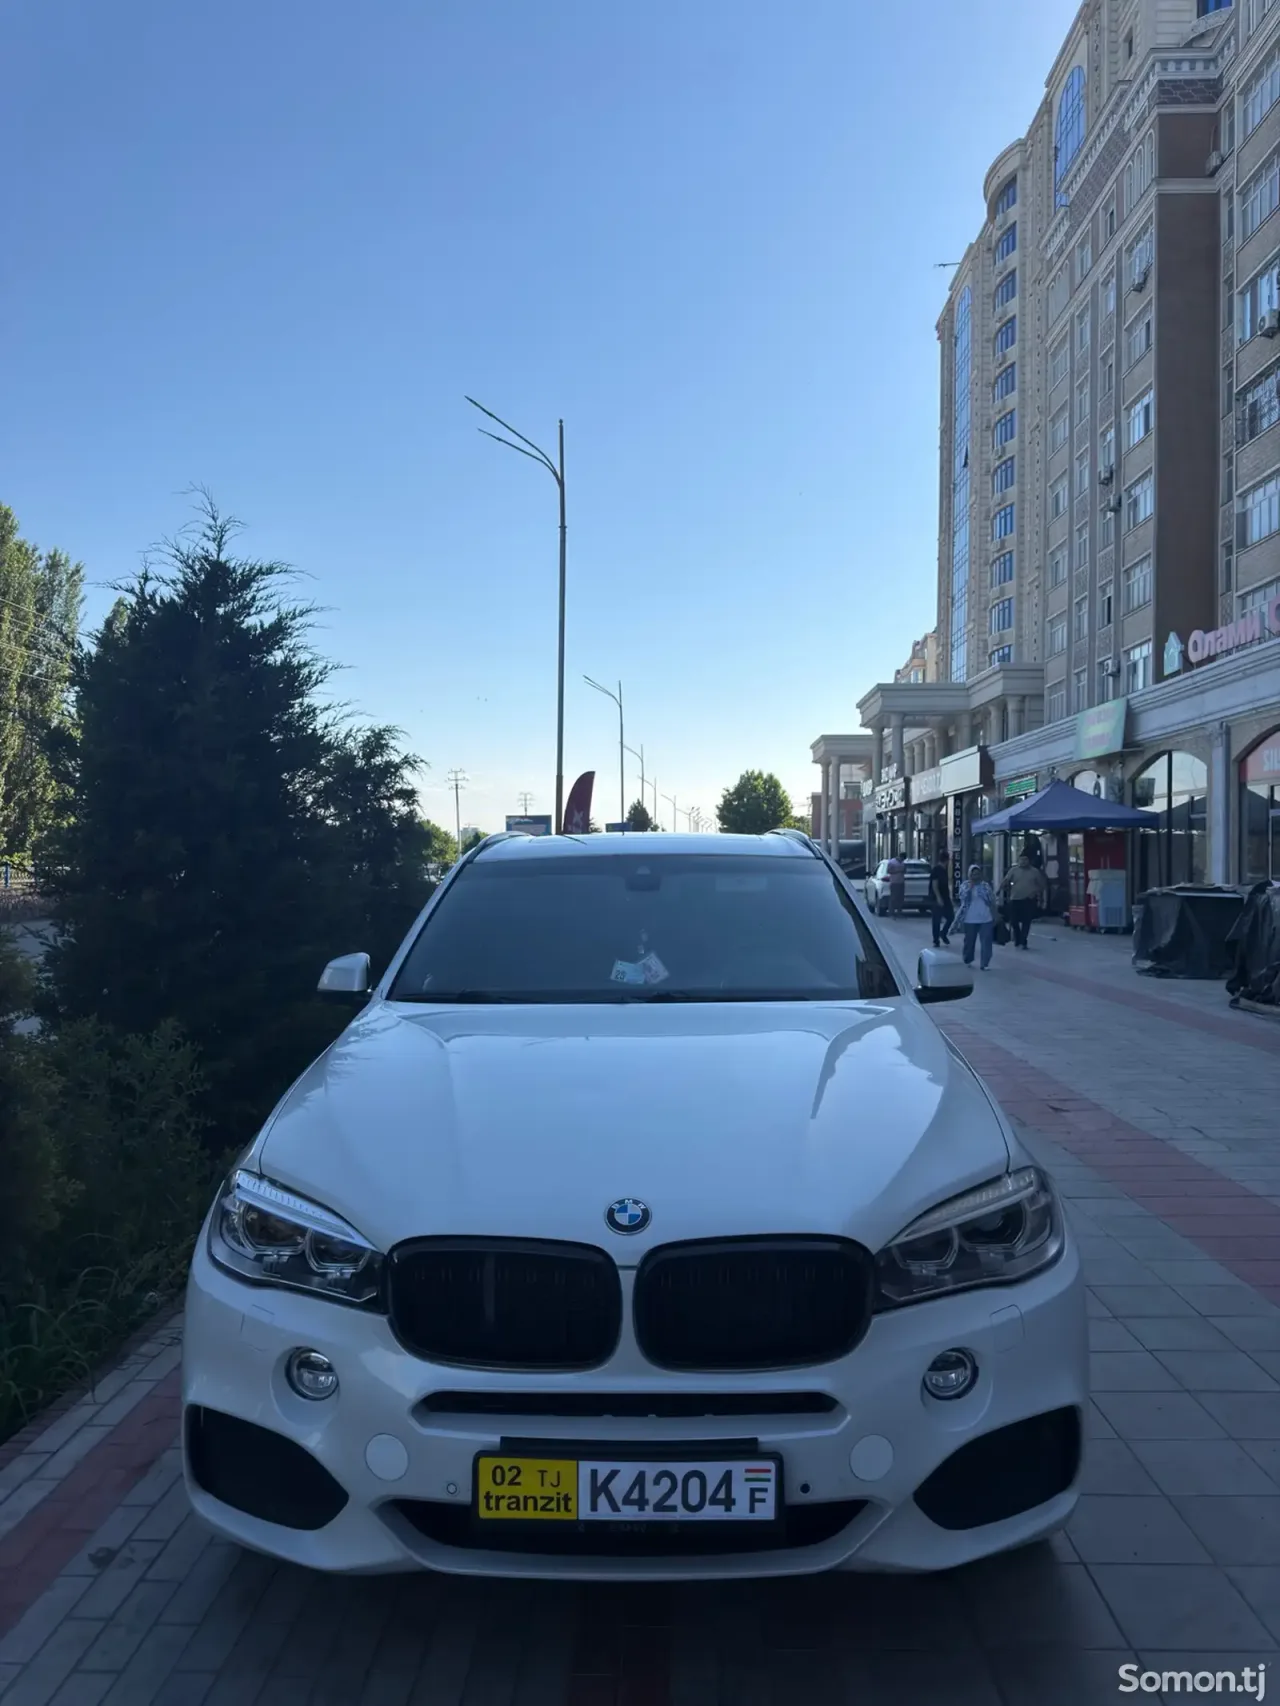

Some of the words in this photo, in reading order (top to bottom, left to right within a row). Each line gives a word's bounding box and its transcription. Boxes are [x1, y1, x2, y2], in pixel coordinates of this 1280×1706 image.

[1188, 612, 1262, 662] Олами
[491, 1465, 522, 1487] 02
[537, 1469, 561, 1488] TJ
[484, 1490, 572, 1513] tranzit
[590, 1468, 736, 1513] K4204
[749, 1487, 768, 1514] F
